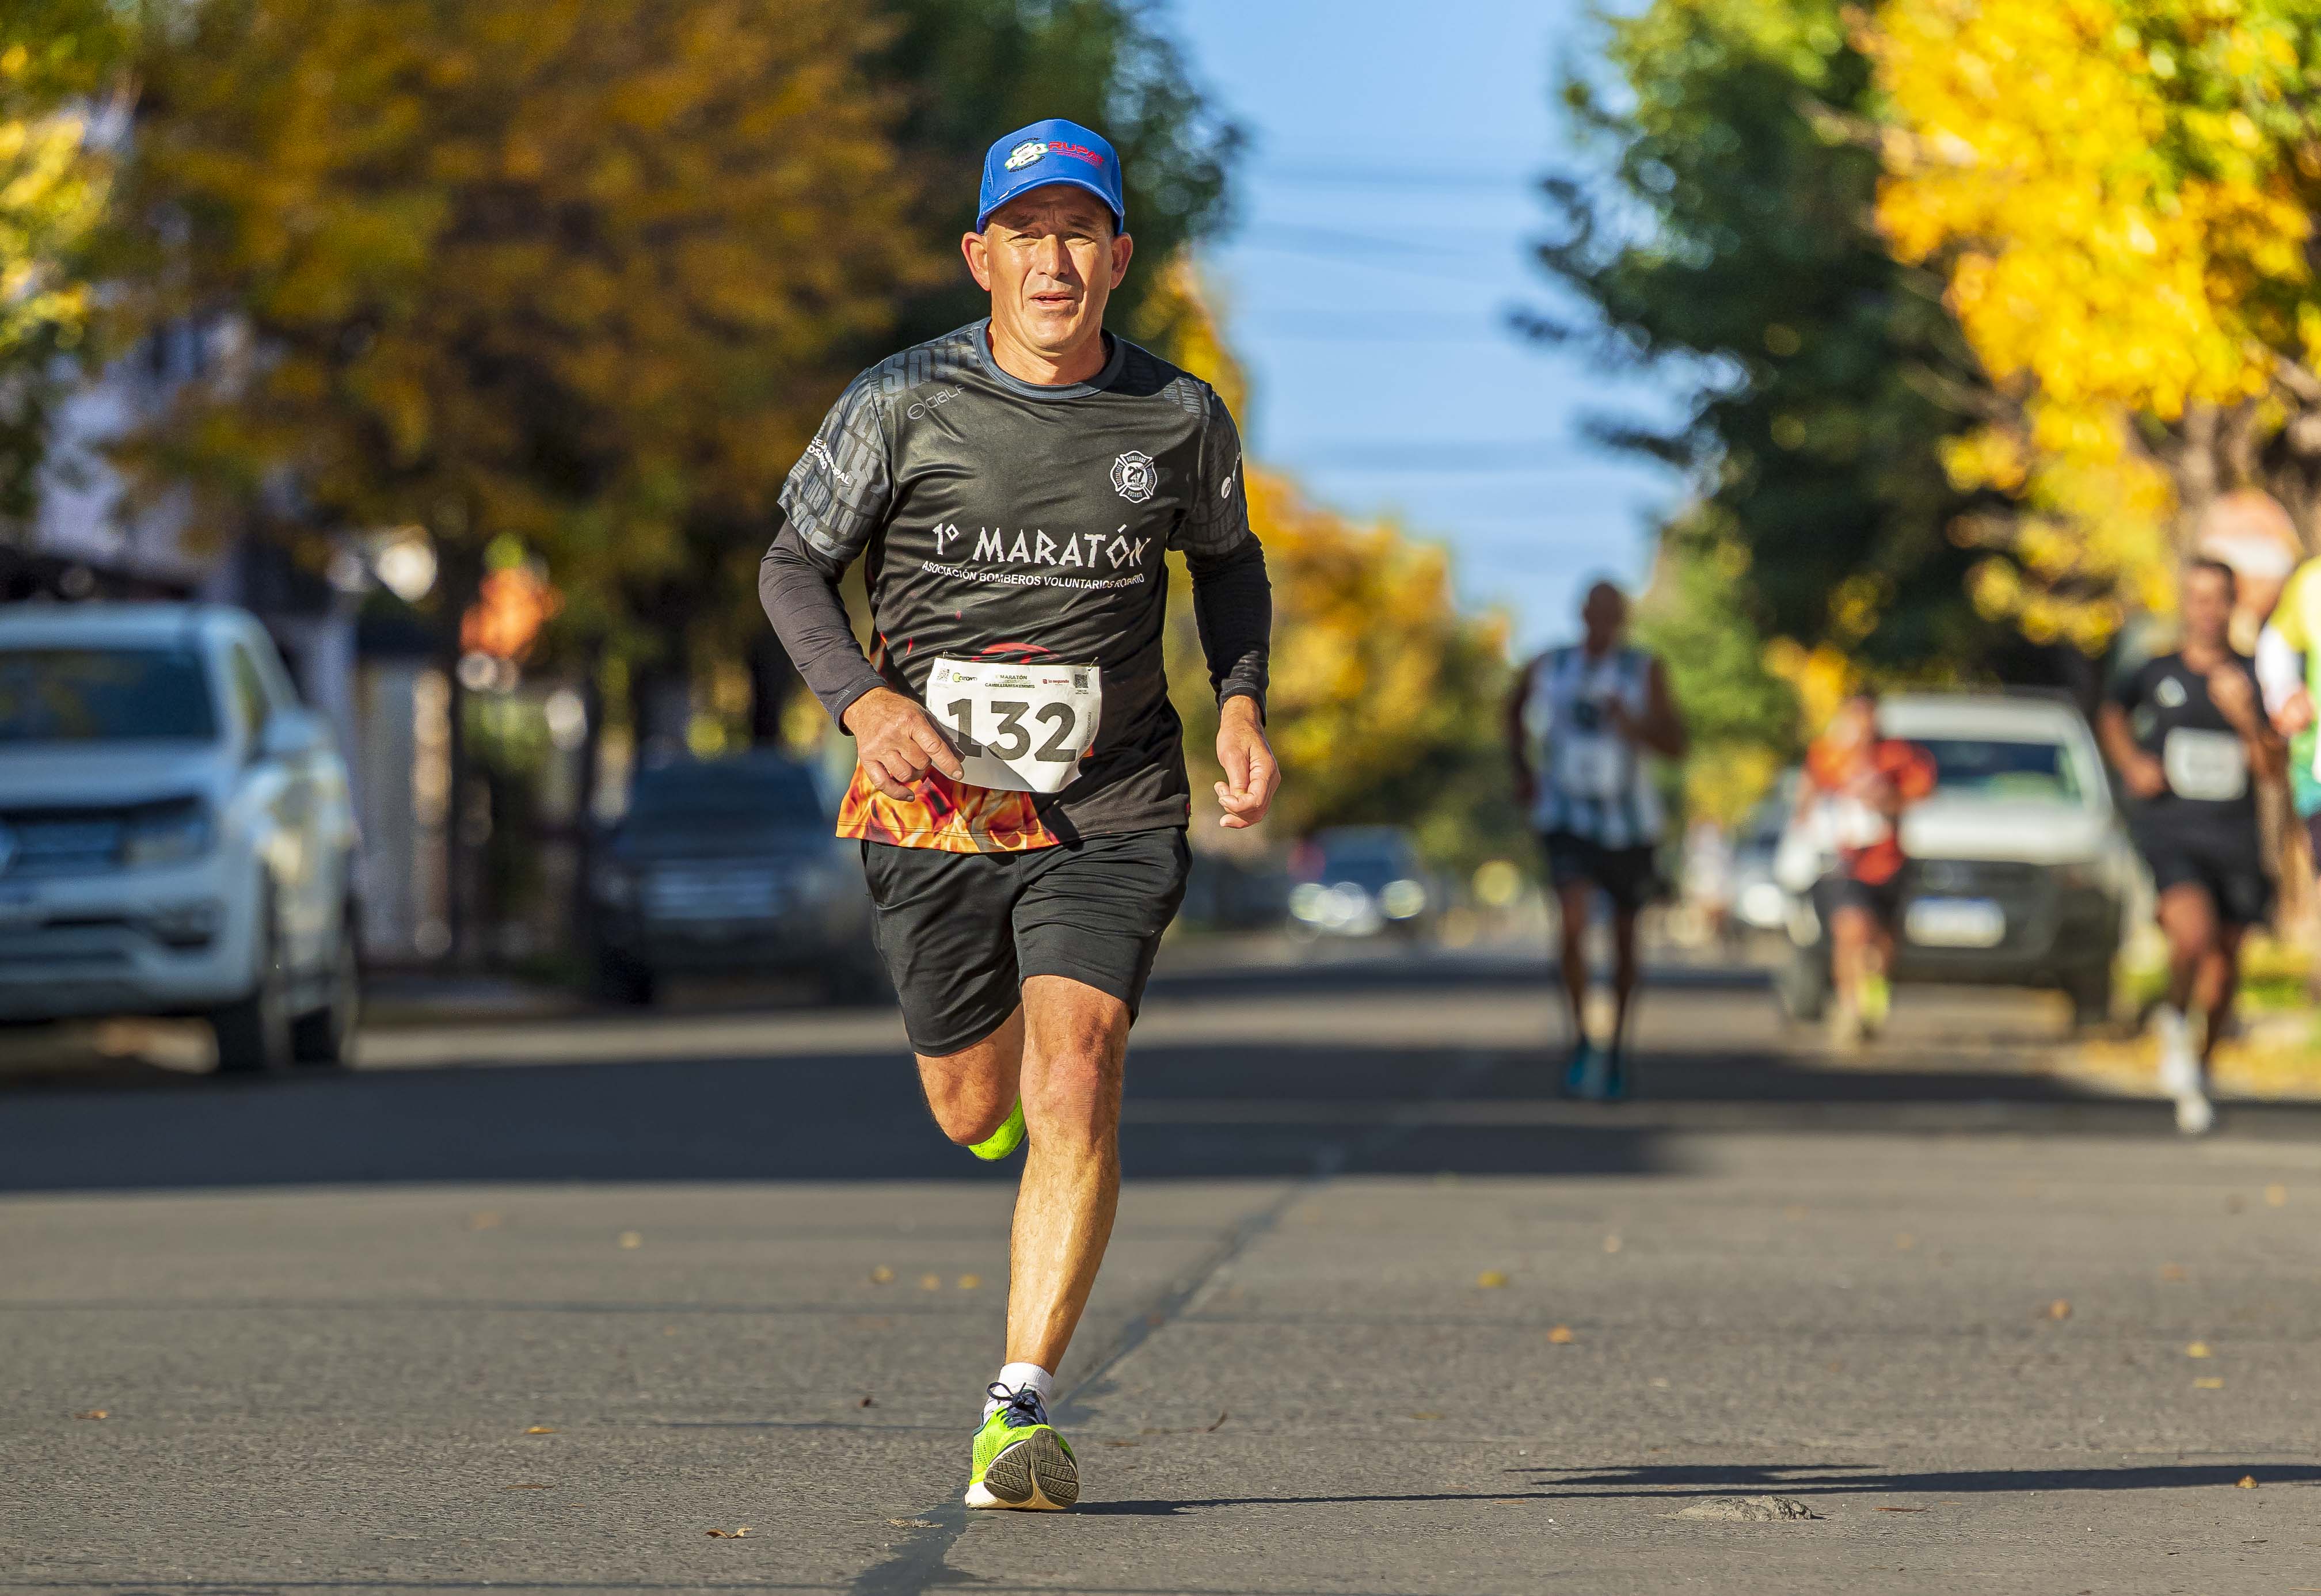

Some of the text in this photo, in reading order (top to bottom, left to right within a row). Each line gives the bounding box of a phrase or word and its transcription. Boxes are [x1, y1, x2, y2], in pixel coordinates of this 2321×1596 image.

[972, 524, 1151, 569] MARATÓN
[922, 561, 977, 581] ASOCIACIÓN
[979, 573, 1041, 586] BOMBEROS
[1044, 576, 1114, 589] VOLUNTARIOS
[947, 698, 1076, 763] 132
